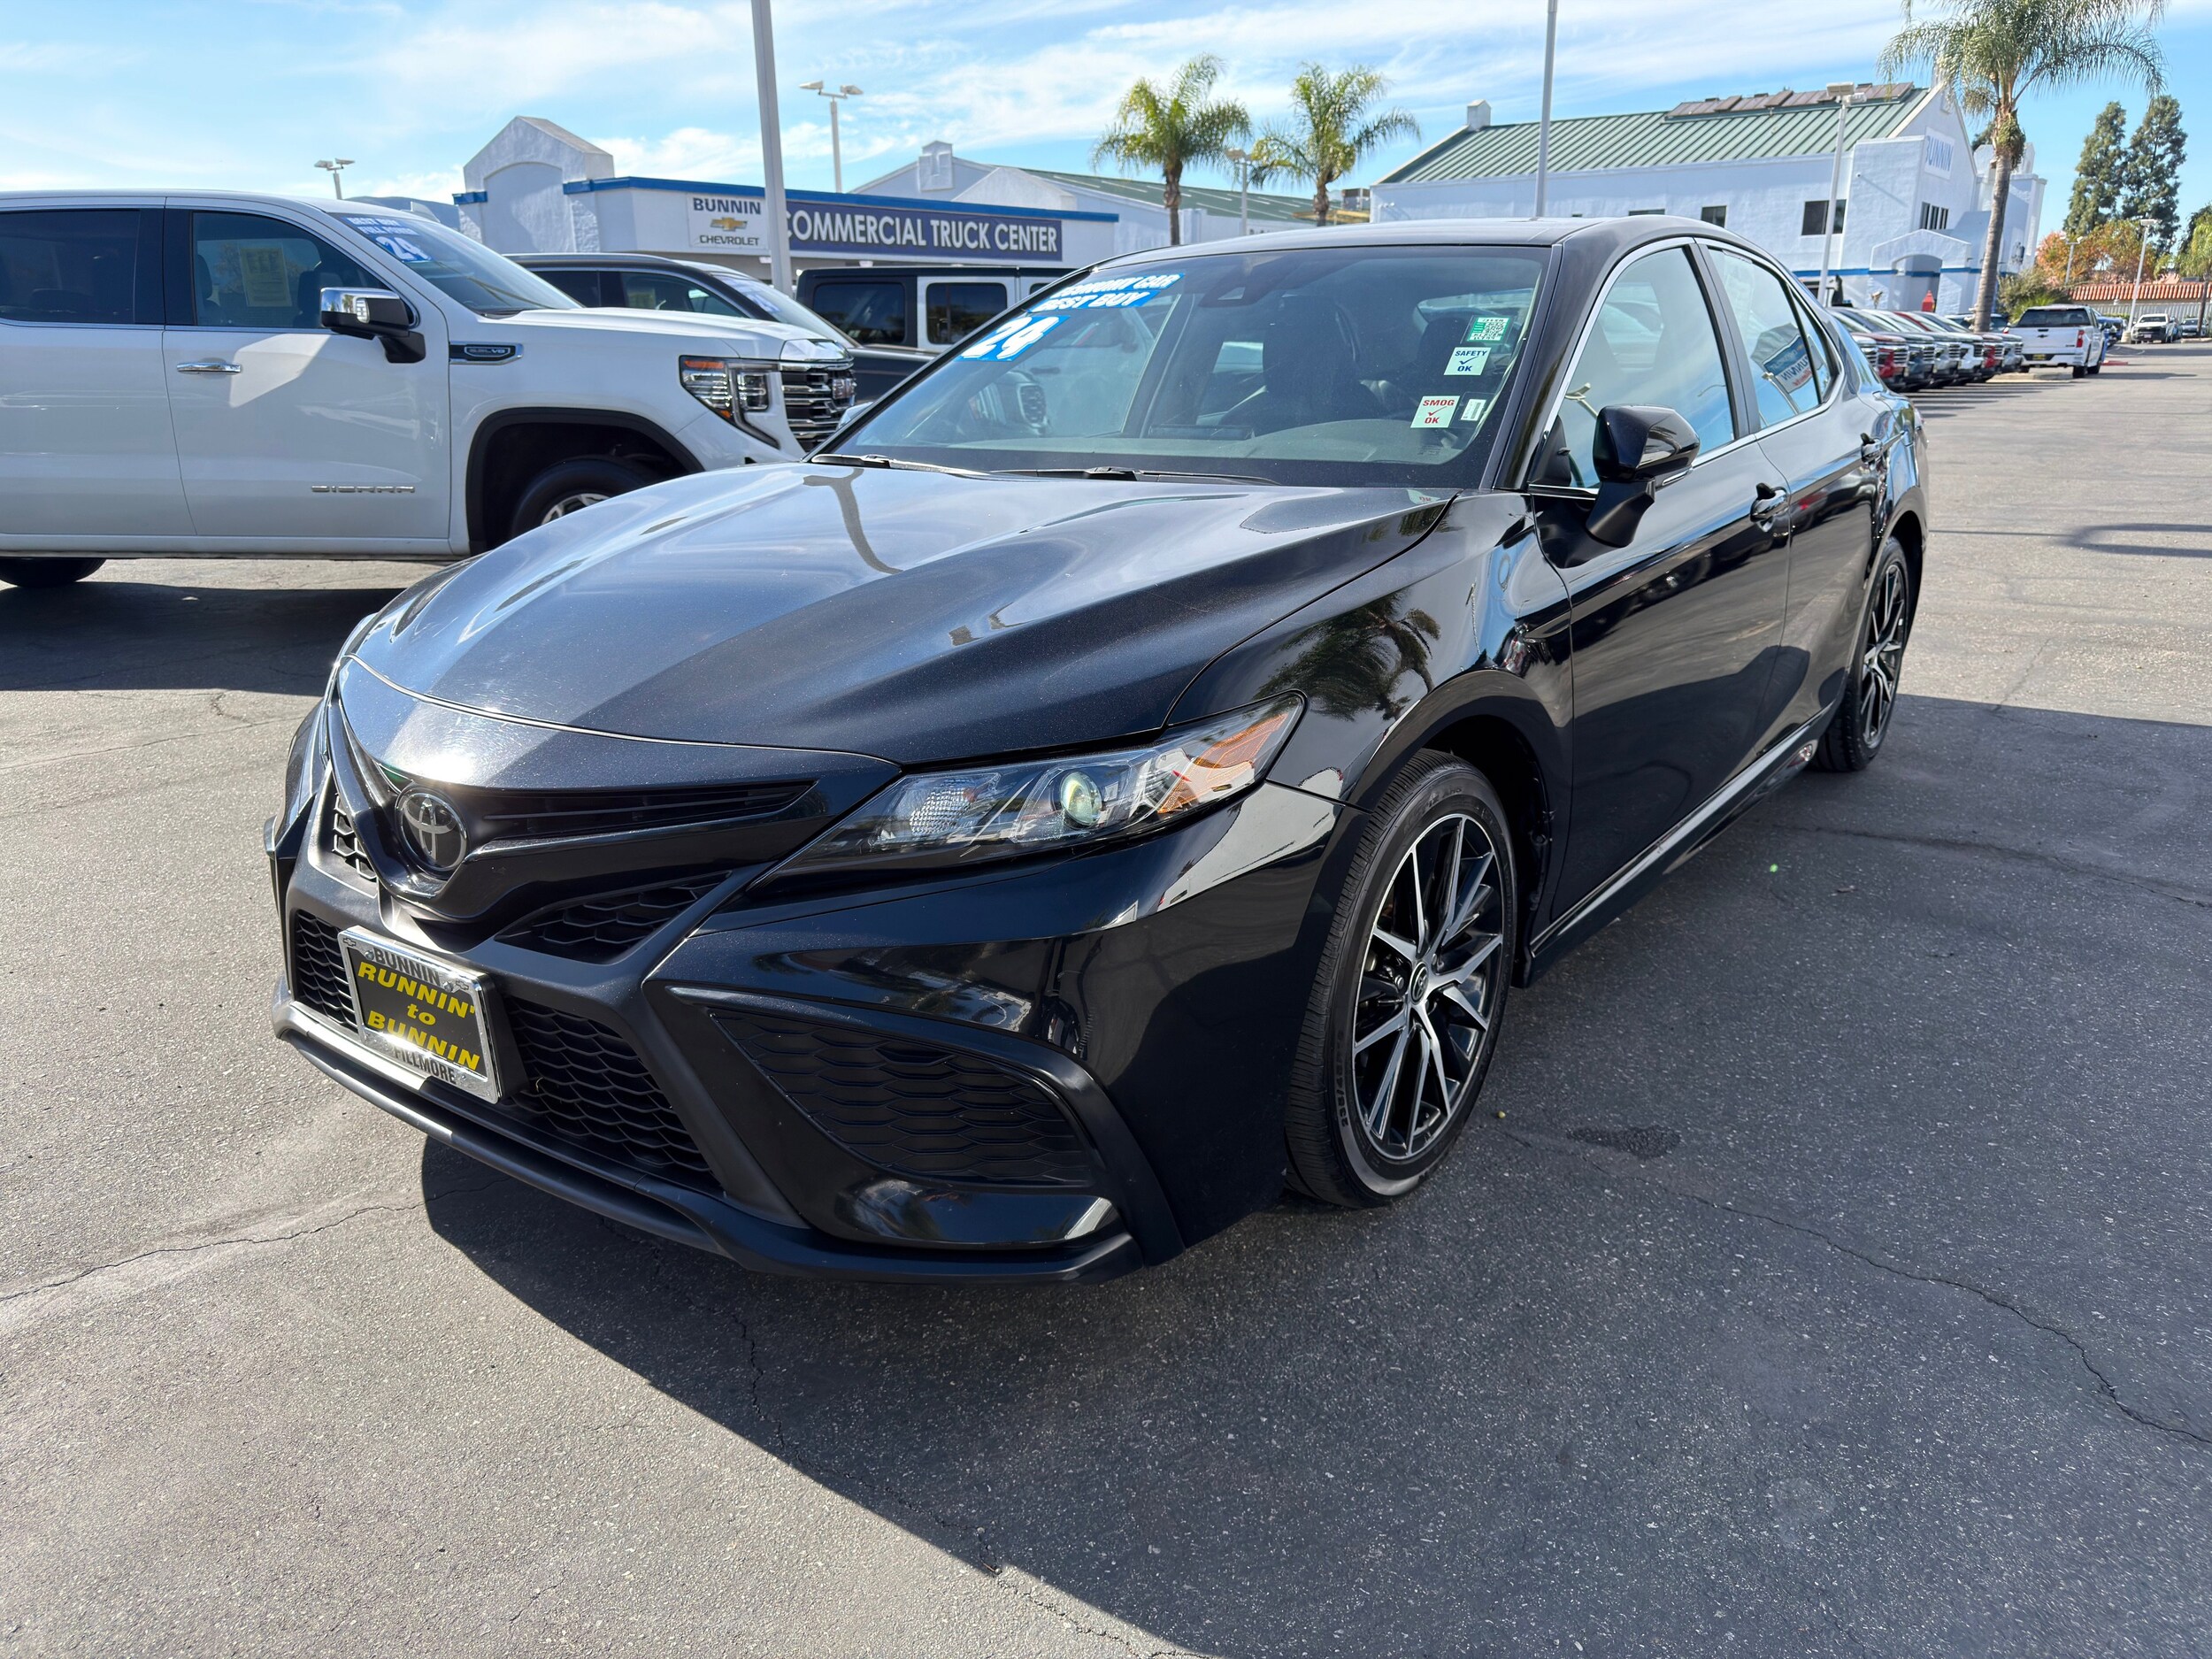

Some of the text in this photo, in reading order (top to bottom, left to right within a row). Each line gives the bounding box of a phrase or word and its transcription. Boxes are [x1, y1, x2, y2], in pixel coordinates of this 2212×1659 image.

[693, 197, 761, 215] BUNNIN
[375, 235, 432, 261] 24
[699, 234, 759, 247] CHEVROLET
[930, 219, 991, 250] TRUCK
[994, 224, 1058, 253] CENTER
[1133, 273, 1181, 289] CAR
[1029, 291, 1151, 313] BEST BUY
[961, 316, 1060, 360] 24
[311, 485, 416, 494] SIERRA
[373, 947, 441, 987] BUNNIN
[357, 961, 476, 1018] RUNNIN'
[407, 1003, 436, 1026] to
[367, 1010, 480, 1071] BUNNIN
[393, 1046, 457, 1085] FILLMORE
